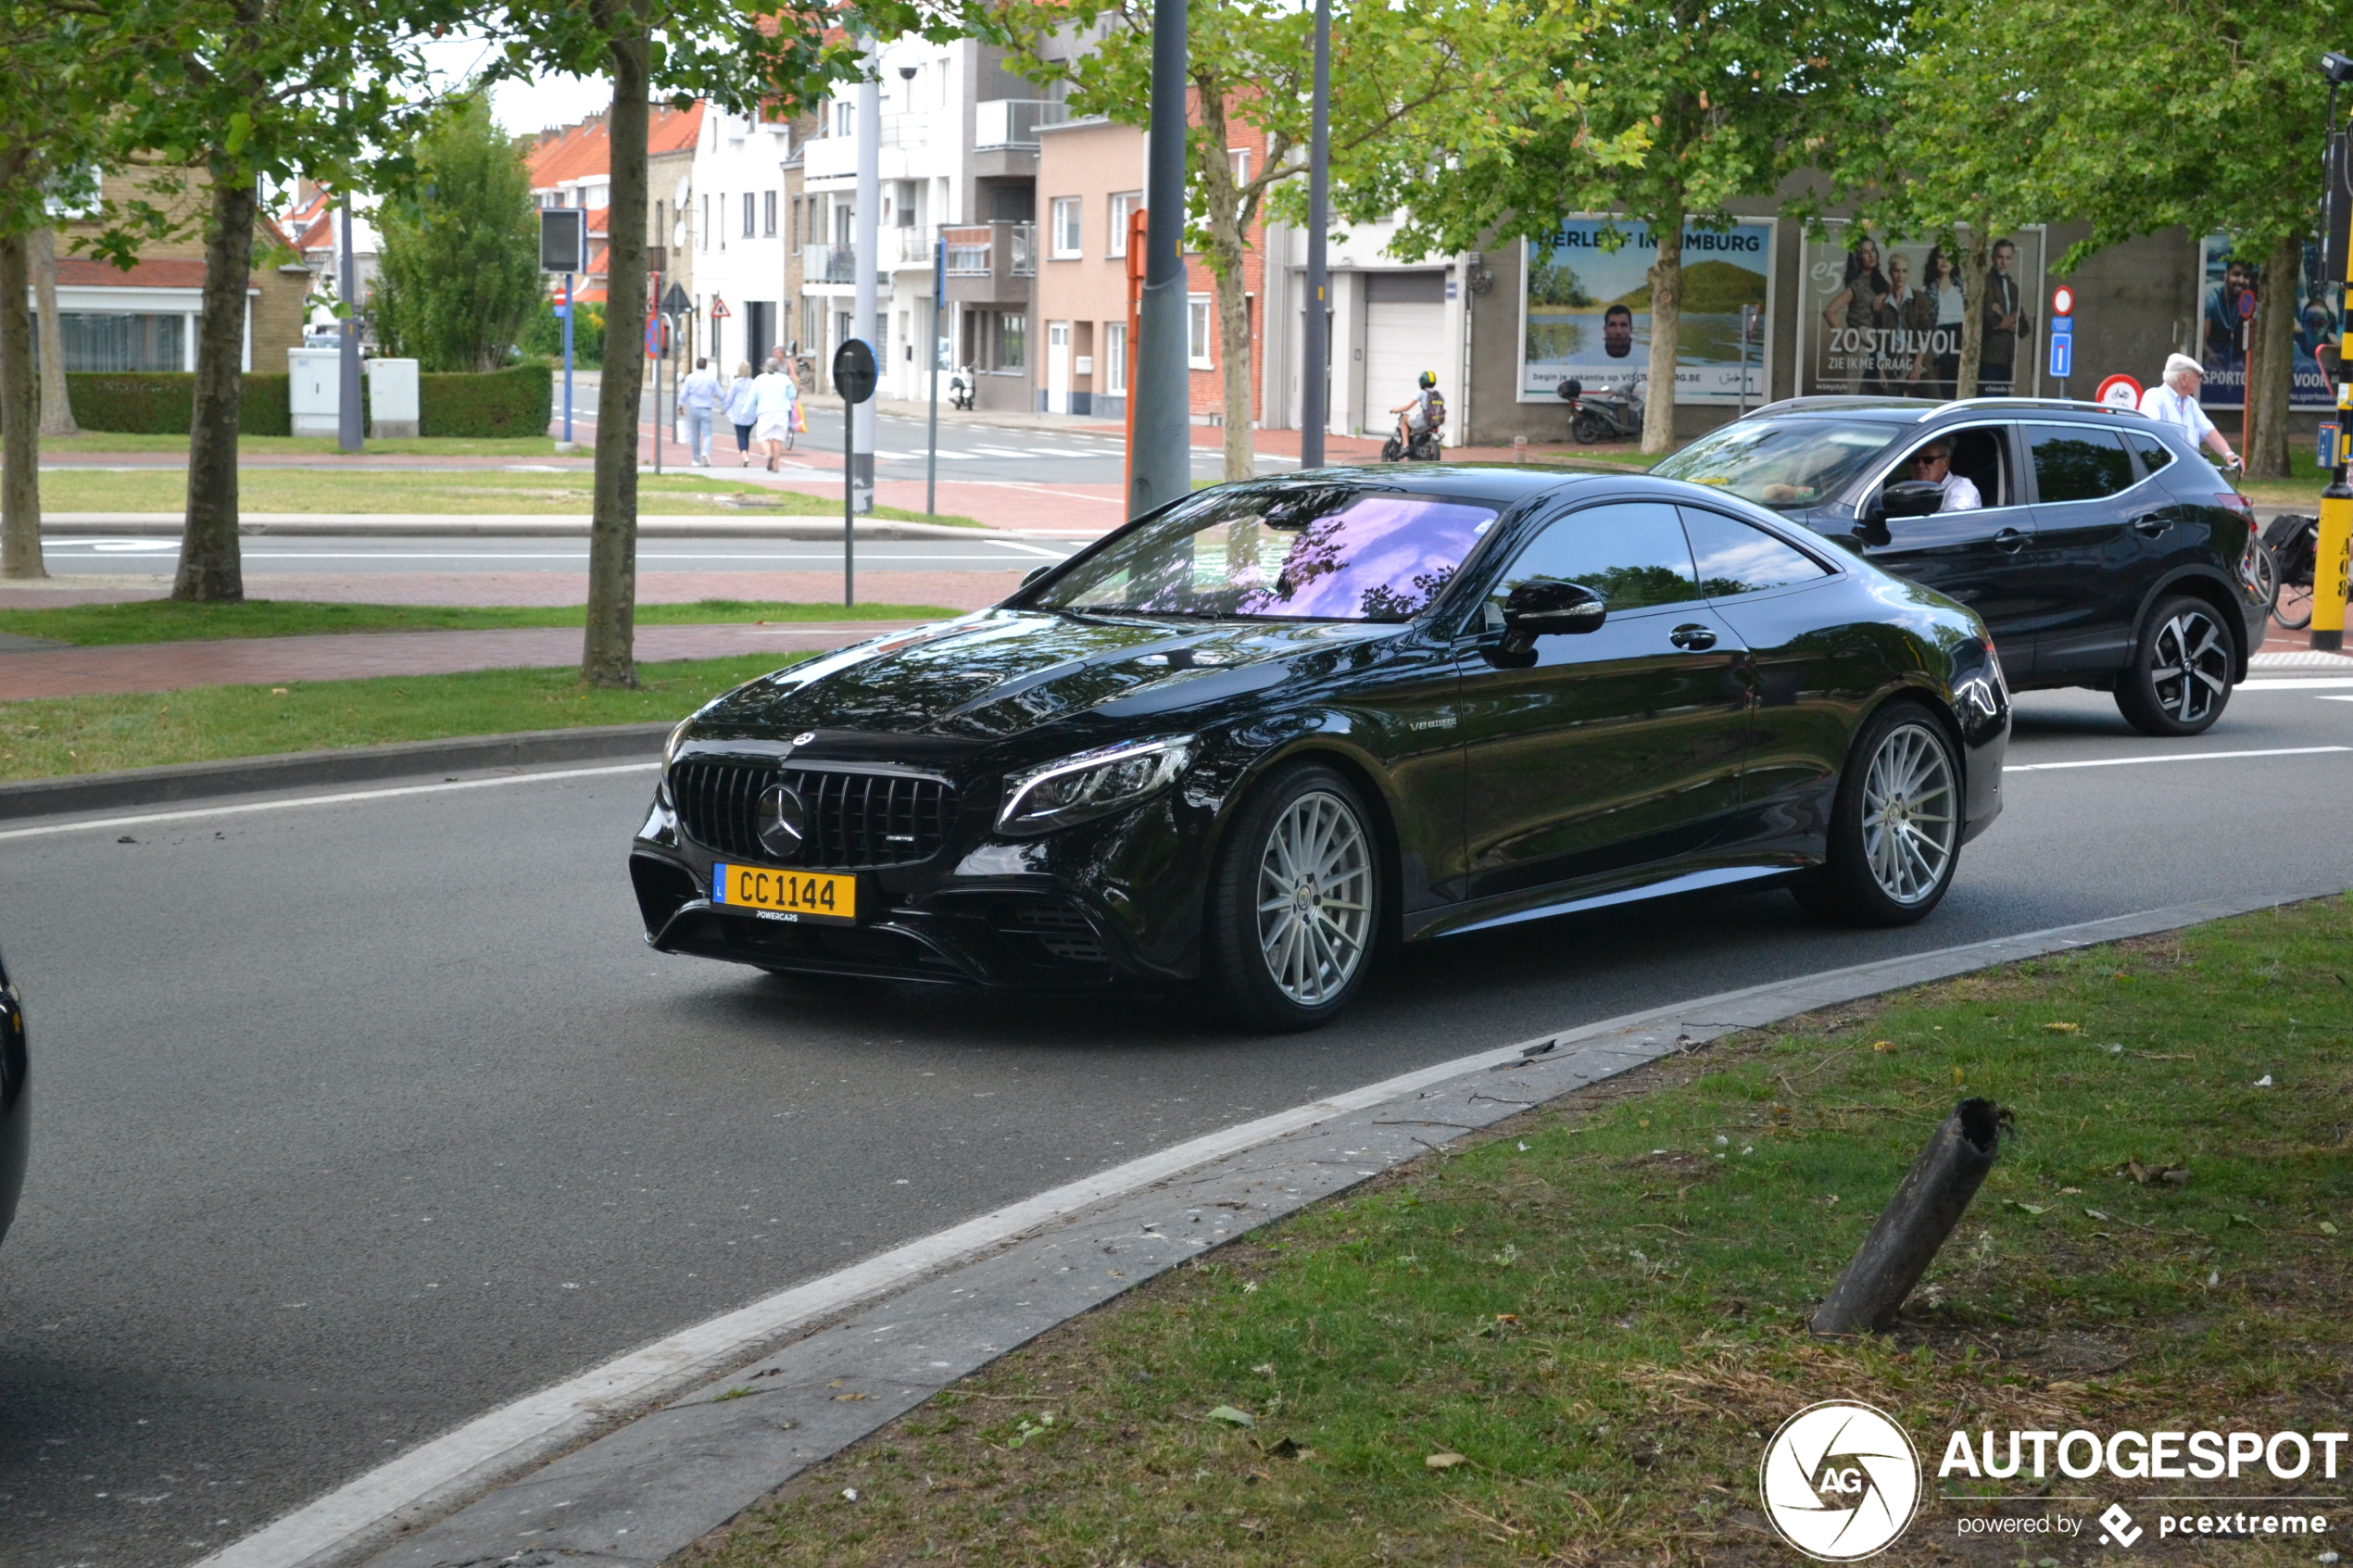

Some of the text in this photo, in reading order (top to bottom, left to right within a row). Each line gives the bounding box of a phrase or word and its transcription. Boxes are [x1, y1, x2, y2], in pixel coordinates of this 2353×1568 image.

[1830, 328, 1961, 355] ZO STIJLVOL
[1829, 357, 1914, 370] ZIE IK ME GRAAG
[1533, 373, 1557, 382] begin
[1559, 373, 1567, 382] je
[1569, 373, 1604, 382] vakantie
[1410, 722, 1427, 731] V8
[717, 885, 722, 897] L
[756, 910, 798, 922] POWERCARS
